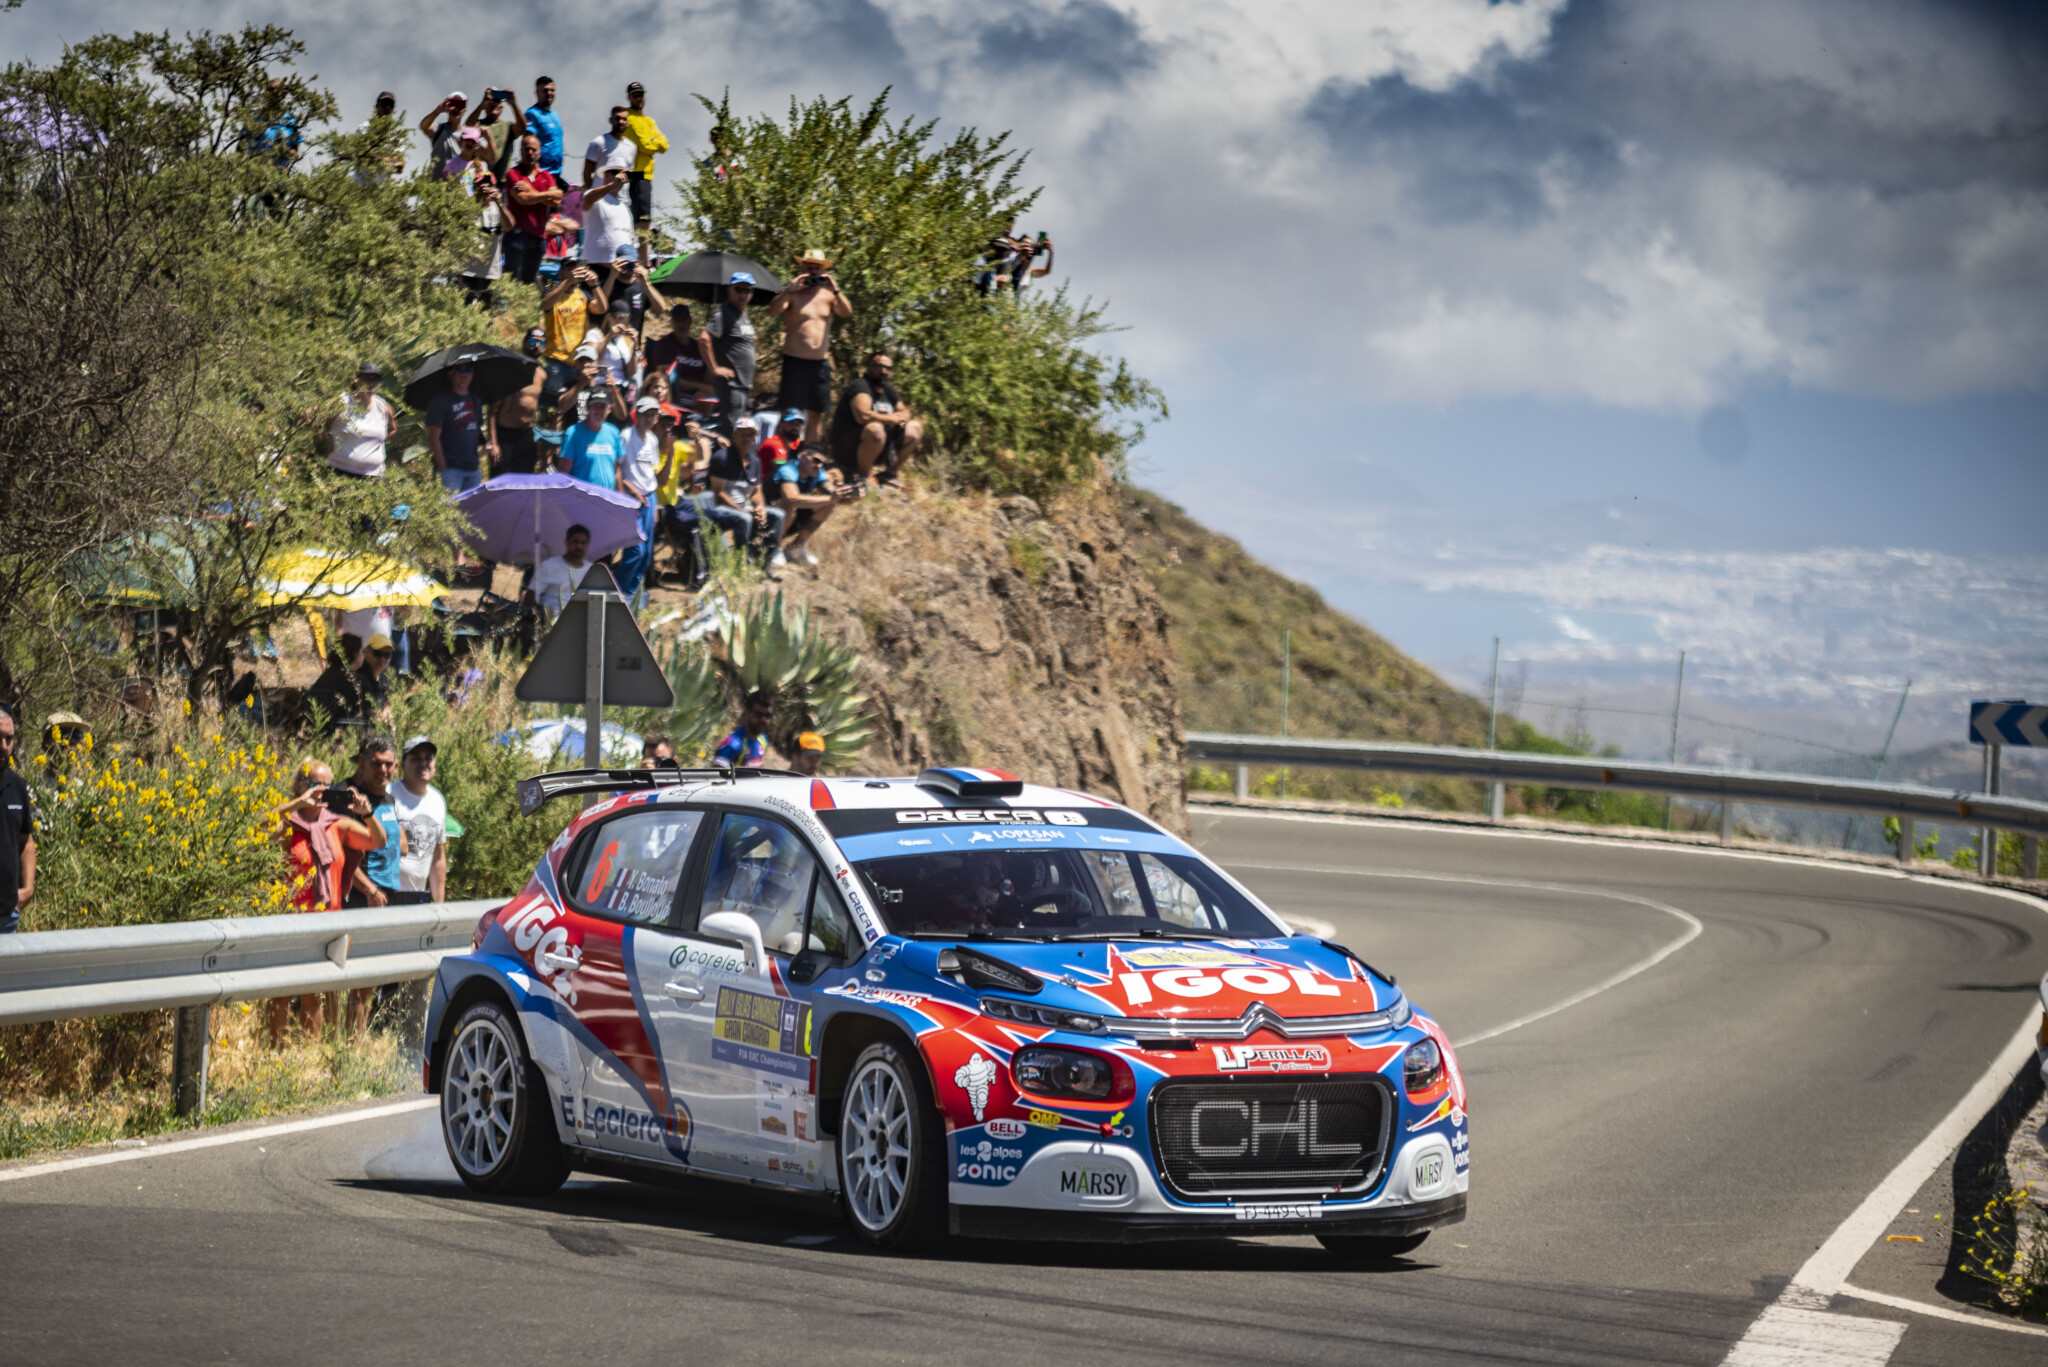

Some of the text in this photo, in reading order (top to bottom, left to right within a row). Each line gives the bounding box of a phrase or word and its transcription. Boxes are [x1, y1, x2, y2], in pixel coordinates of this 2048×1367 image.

[895, 810, 1044, 822] ORECA
[992, 830, 1066, 841] LOPESAN
[586, 841, 619, 904] 6
[627, 869, 669, 896] Y. Bonato
[618, 891, 672, 919] B. Boulloud
[688, 950, 746, 974] corelec
[1118, 968, 1341, 1005] IGOL
[718, 989, 737, 1016] RALLY
[724, 1020, 742, 1041] GRAN
[742, 1022, 770, 1048] CANARIA
[739, 1049, 748, 1059] FIA
[749, 1051, 759, 1061] ERC
[760, 1054, 797, 1073] Championship
[989, 1122, 1022, 1134] BELL
[1029, 1110, 1061, 1125] OMP
[1192, 1100, 1362, 1156] CHL
[960, 1141, 1023, 1162] les 2 alpes
[1061, 1170, 1127, 1195] MARSY
[1415, 1160, 1444, 1188] MARSY
[1243, 1204, 1314, 1219] FJ-449-CT
